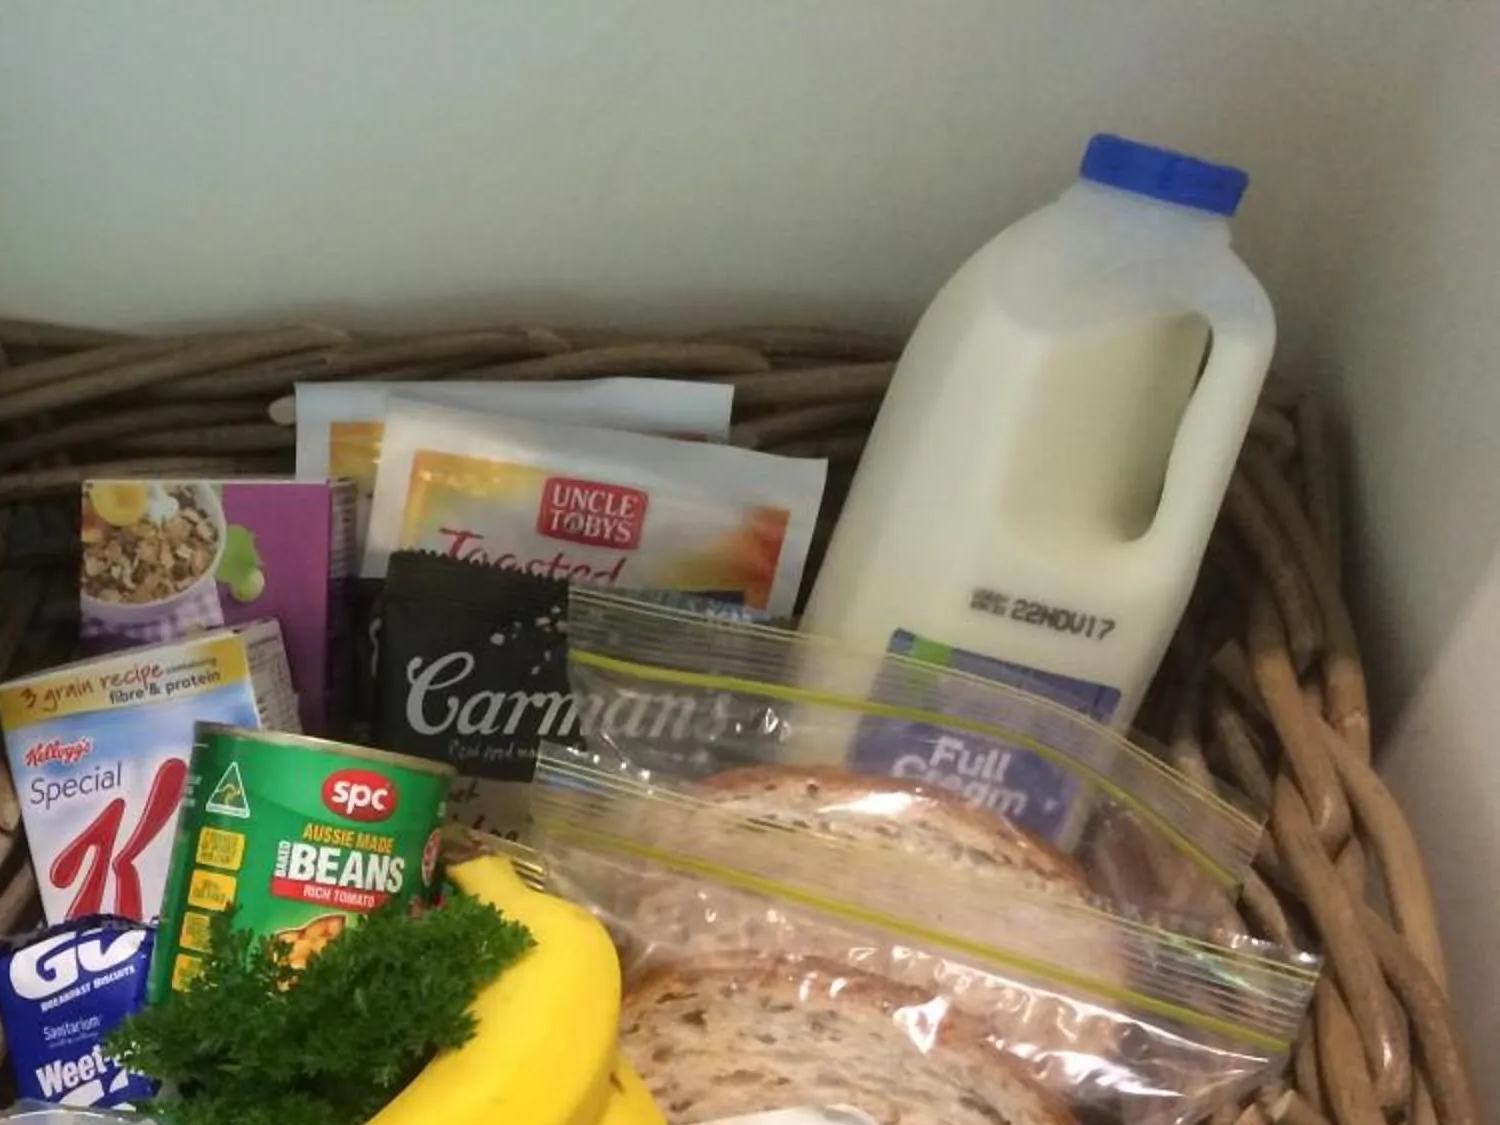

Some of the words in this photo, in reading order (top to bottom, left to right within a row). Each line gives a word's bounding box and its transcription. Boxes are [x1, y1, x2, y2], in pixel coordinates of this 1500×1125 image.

[552, 484, 636, 518] UNCLE
[549, 509, 633, 543] TOBYS
[1011, 599, 1116, 640] 22NOV17
[20, 686, 38, 708] 3
[42, 680, 94, 713] grain
[100, 662, 164, 690] recipe
[109, 685, 144, 705] fibre
[164, 670, 221, 697] protein
[25, 736, 93, 768] Kellogg's
[929, 736, 1012, 783] Full
[30, 761, 122, 810] Special
[332, 780, 388, 814] spc
[303, 822, 355, 848] AUSSIE
[355, 832, 395, 854] MADE
[274, 840, 292, 878] BAKED
[289, 843, 405, 893] BEANS
[303, 884, 331, 900] RICH
[332, 888, 376, 908] TOMATO
